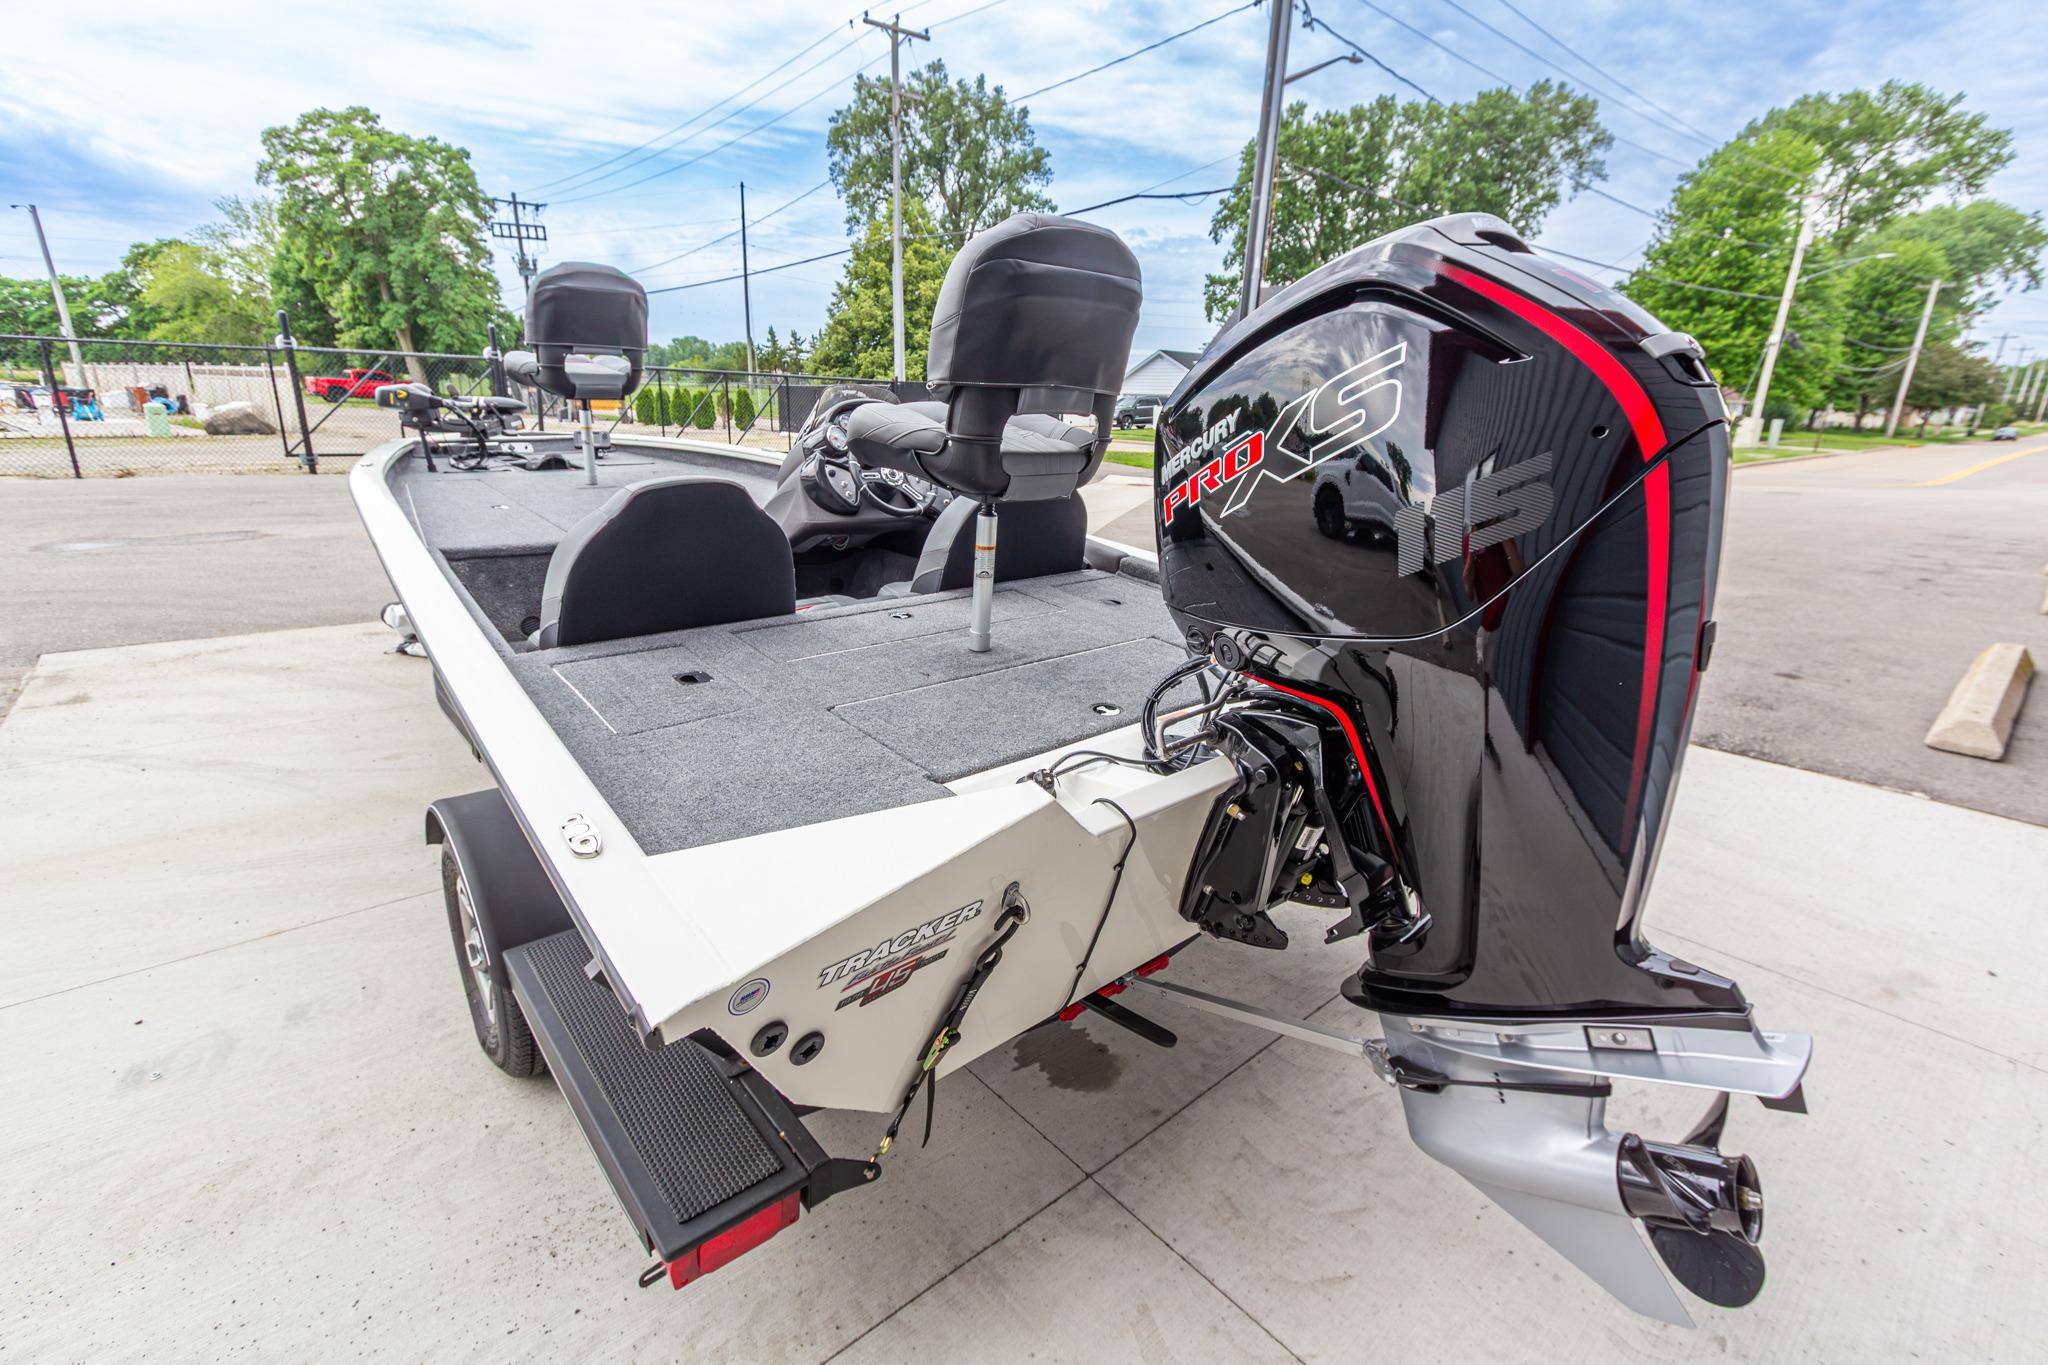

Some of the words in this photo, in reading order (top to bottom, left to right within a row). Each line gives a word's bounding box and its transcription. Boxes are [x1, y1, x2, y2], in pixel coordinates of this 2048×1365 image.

[1161, 407, 1242, 486] MERCURY
[1163, 430, 1265, 527] PRO
[1220, 341, 1408, 518] XS
[1393, 450, 1555, 578] 115
[816, 899, 985, 990] TRACKER
